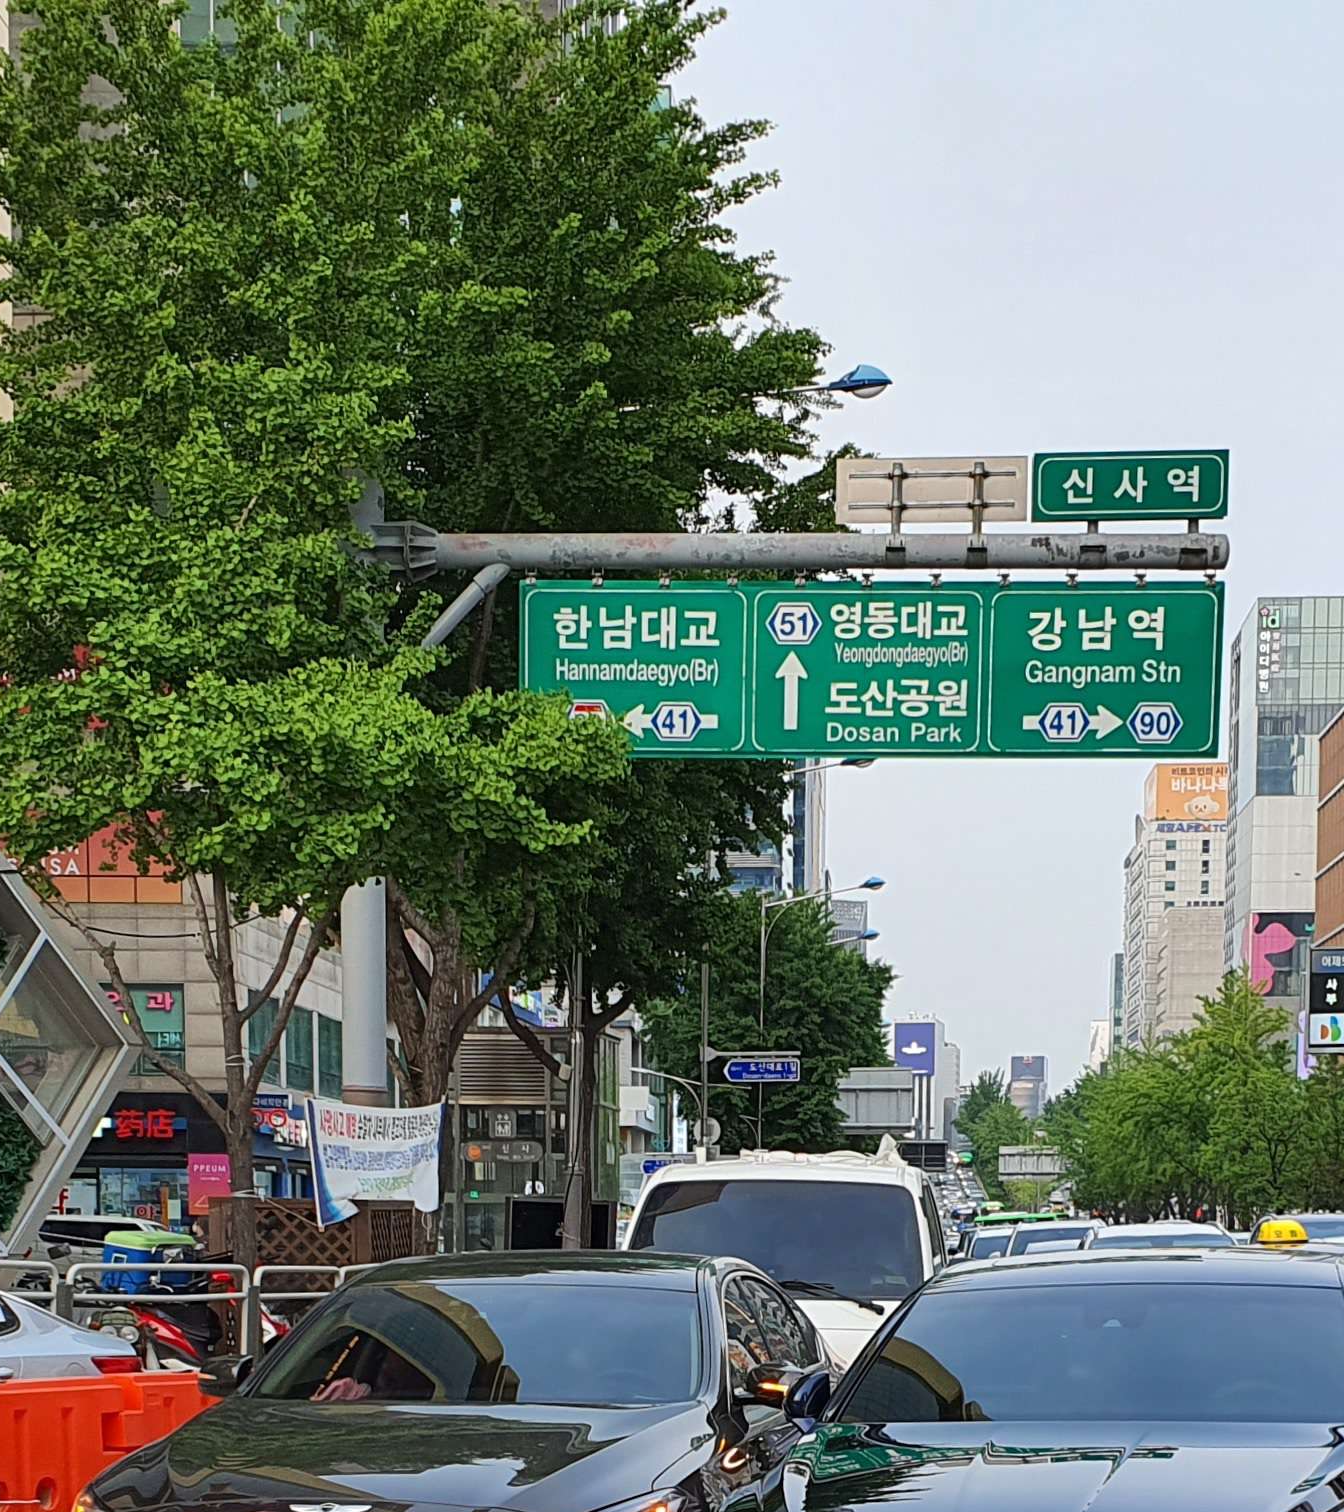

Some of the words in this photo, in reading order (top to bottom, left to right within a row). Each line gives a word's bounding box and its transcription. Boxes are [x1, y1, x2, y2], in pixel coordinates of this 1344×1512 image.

[553, 605, 721, 650] 한남대교
[779, 612, 809, 636] 51
[830, 602, 969, 640] 영동대교
[1026, 606, 1167, 651] 강남역
[834, 641, 969, 668] Yeongdongdaegyo(Br)
[555, 658, 719, 687] Hannamdaegyo(Br)
[1024, 659, 1136, 689] Gangnam
[1141, 658, 1182, 684] Stn
[824, 679, 969, 718] 도산공원
[661, 709, 689, 734] 41
[826, 721, 900, 743] Dosan
[910, 721, 962, 743] Park
[1048, 709, 1078, 736] 41
[1139, 709, 1172, 736] 90
[115, 1109, 177, 1139] 药店
[193, 1163, 227, 1173] PPEUM
